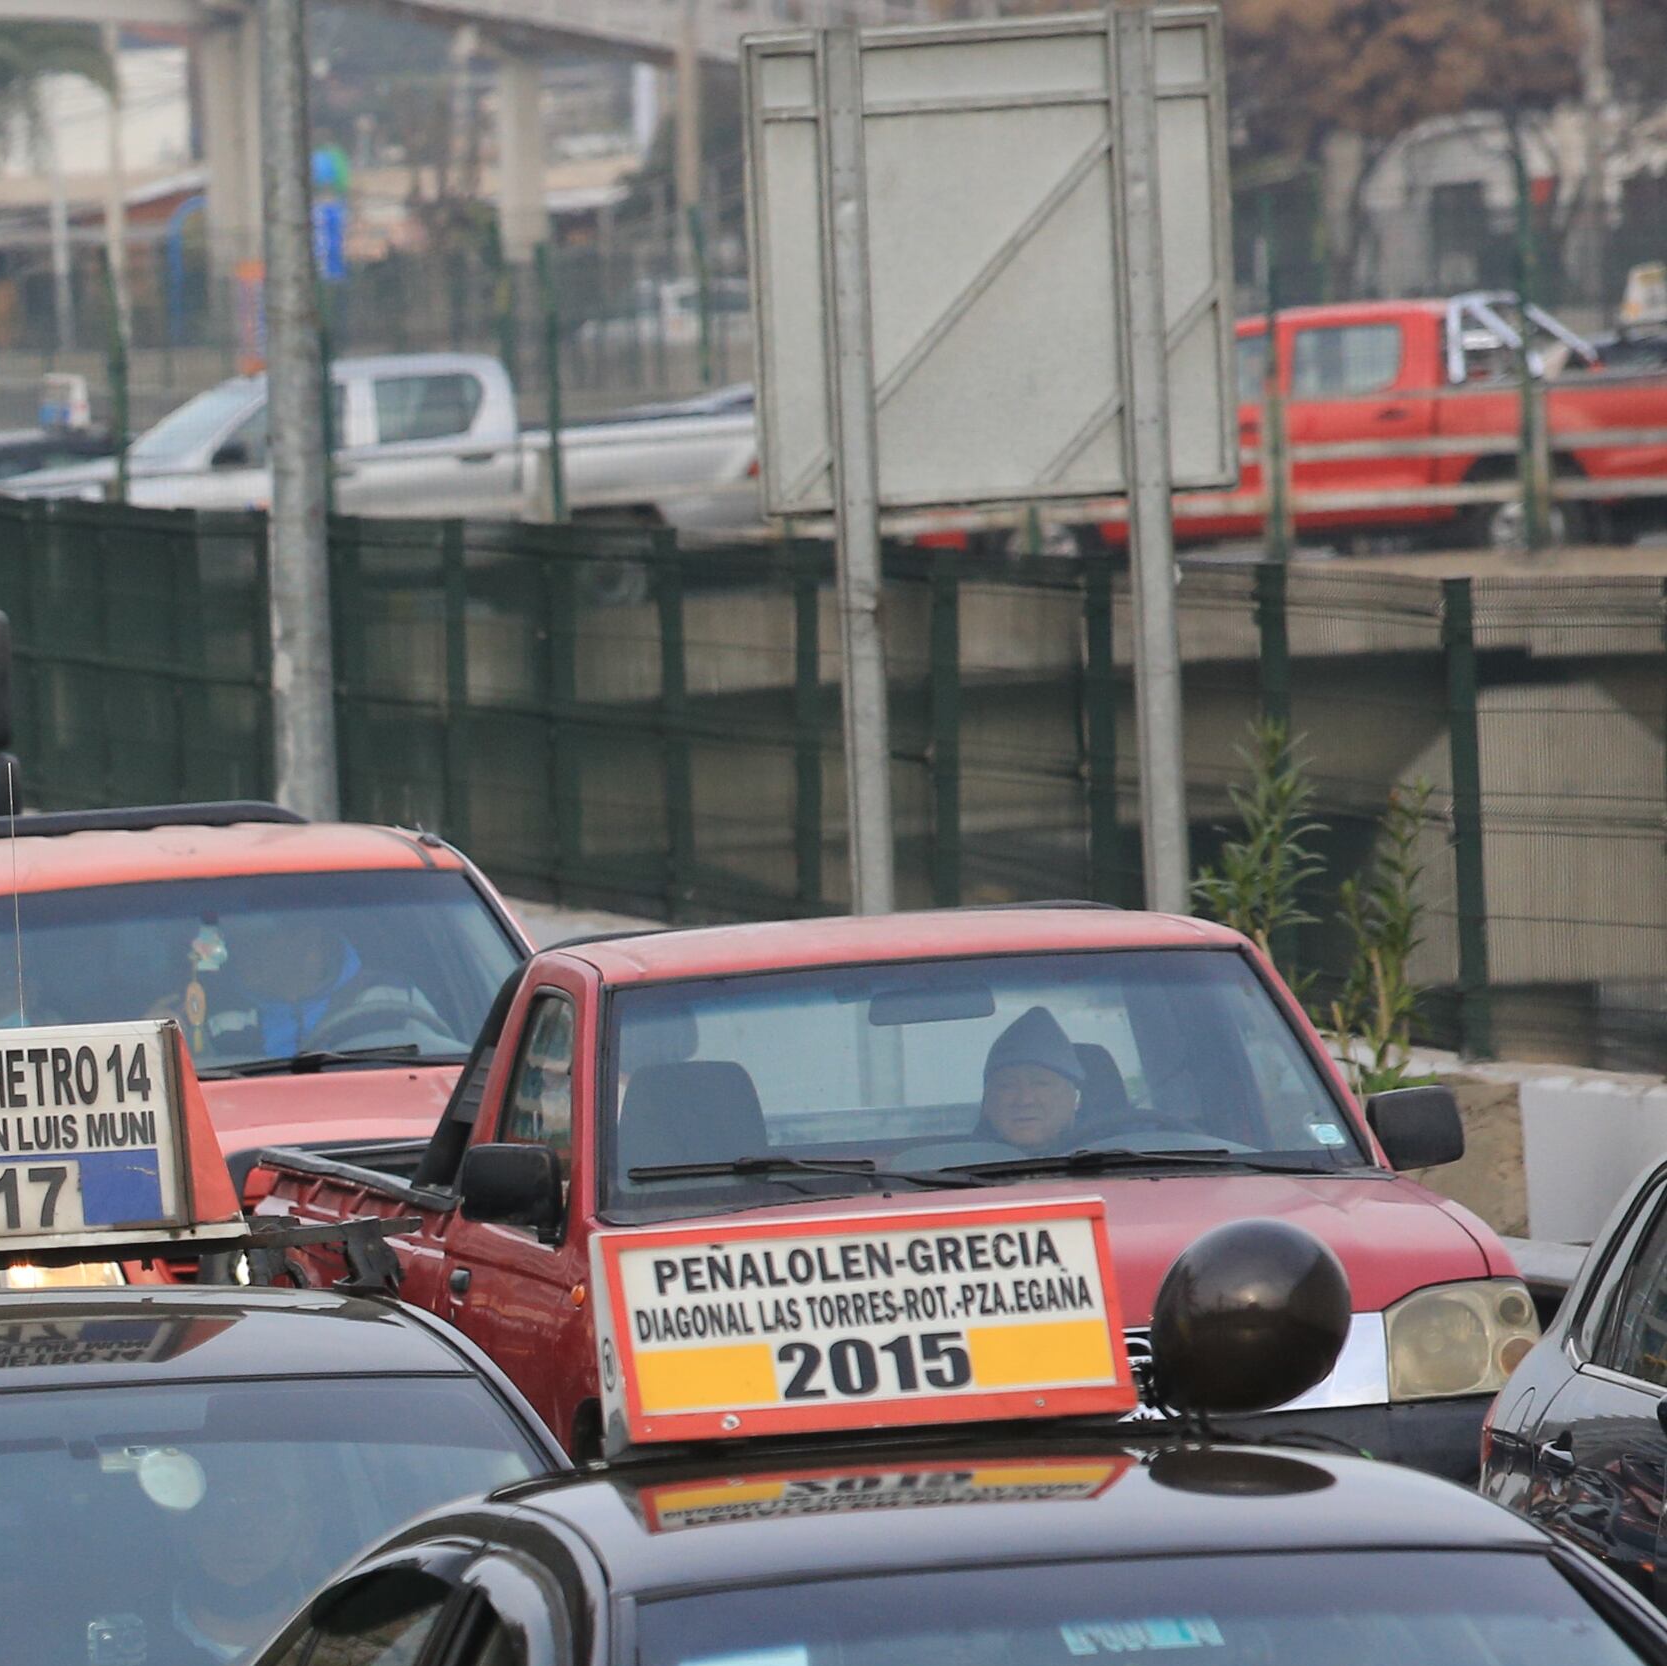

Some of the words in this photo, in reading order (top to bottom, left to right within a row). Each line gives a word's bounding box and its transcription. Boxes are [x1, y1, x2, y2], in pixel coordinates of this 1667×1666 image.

[106, 1042, 152, 1103] 14
[16, 1114, 79, 1150] LUIS
[85, 1110, 157, 1147] MUNI
[635, 1302, 756, 1343] DIAGONAL
[762, 1298, 802, 1332] LAS
[777, 1330, 972, 1400] 2015
